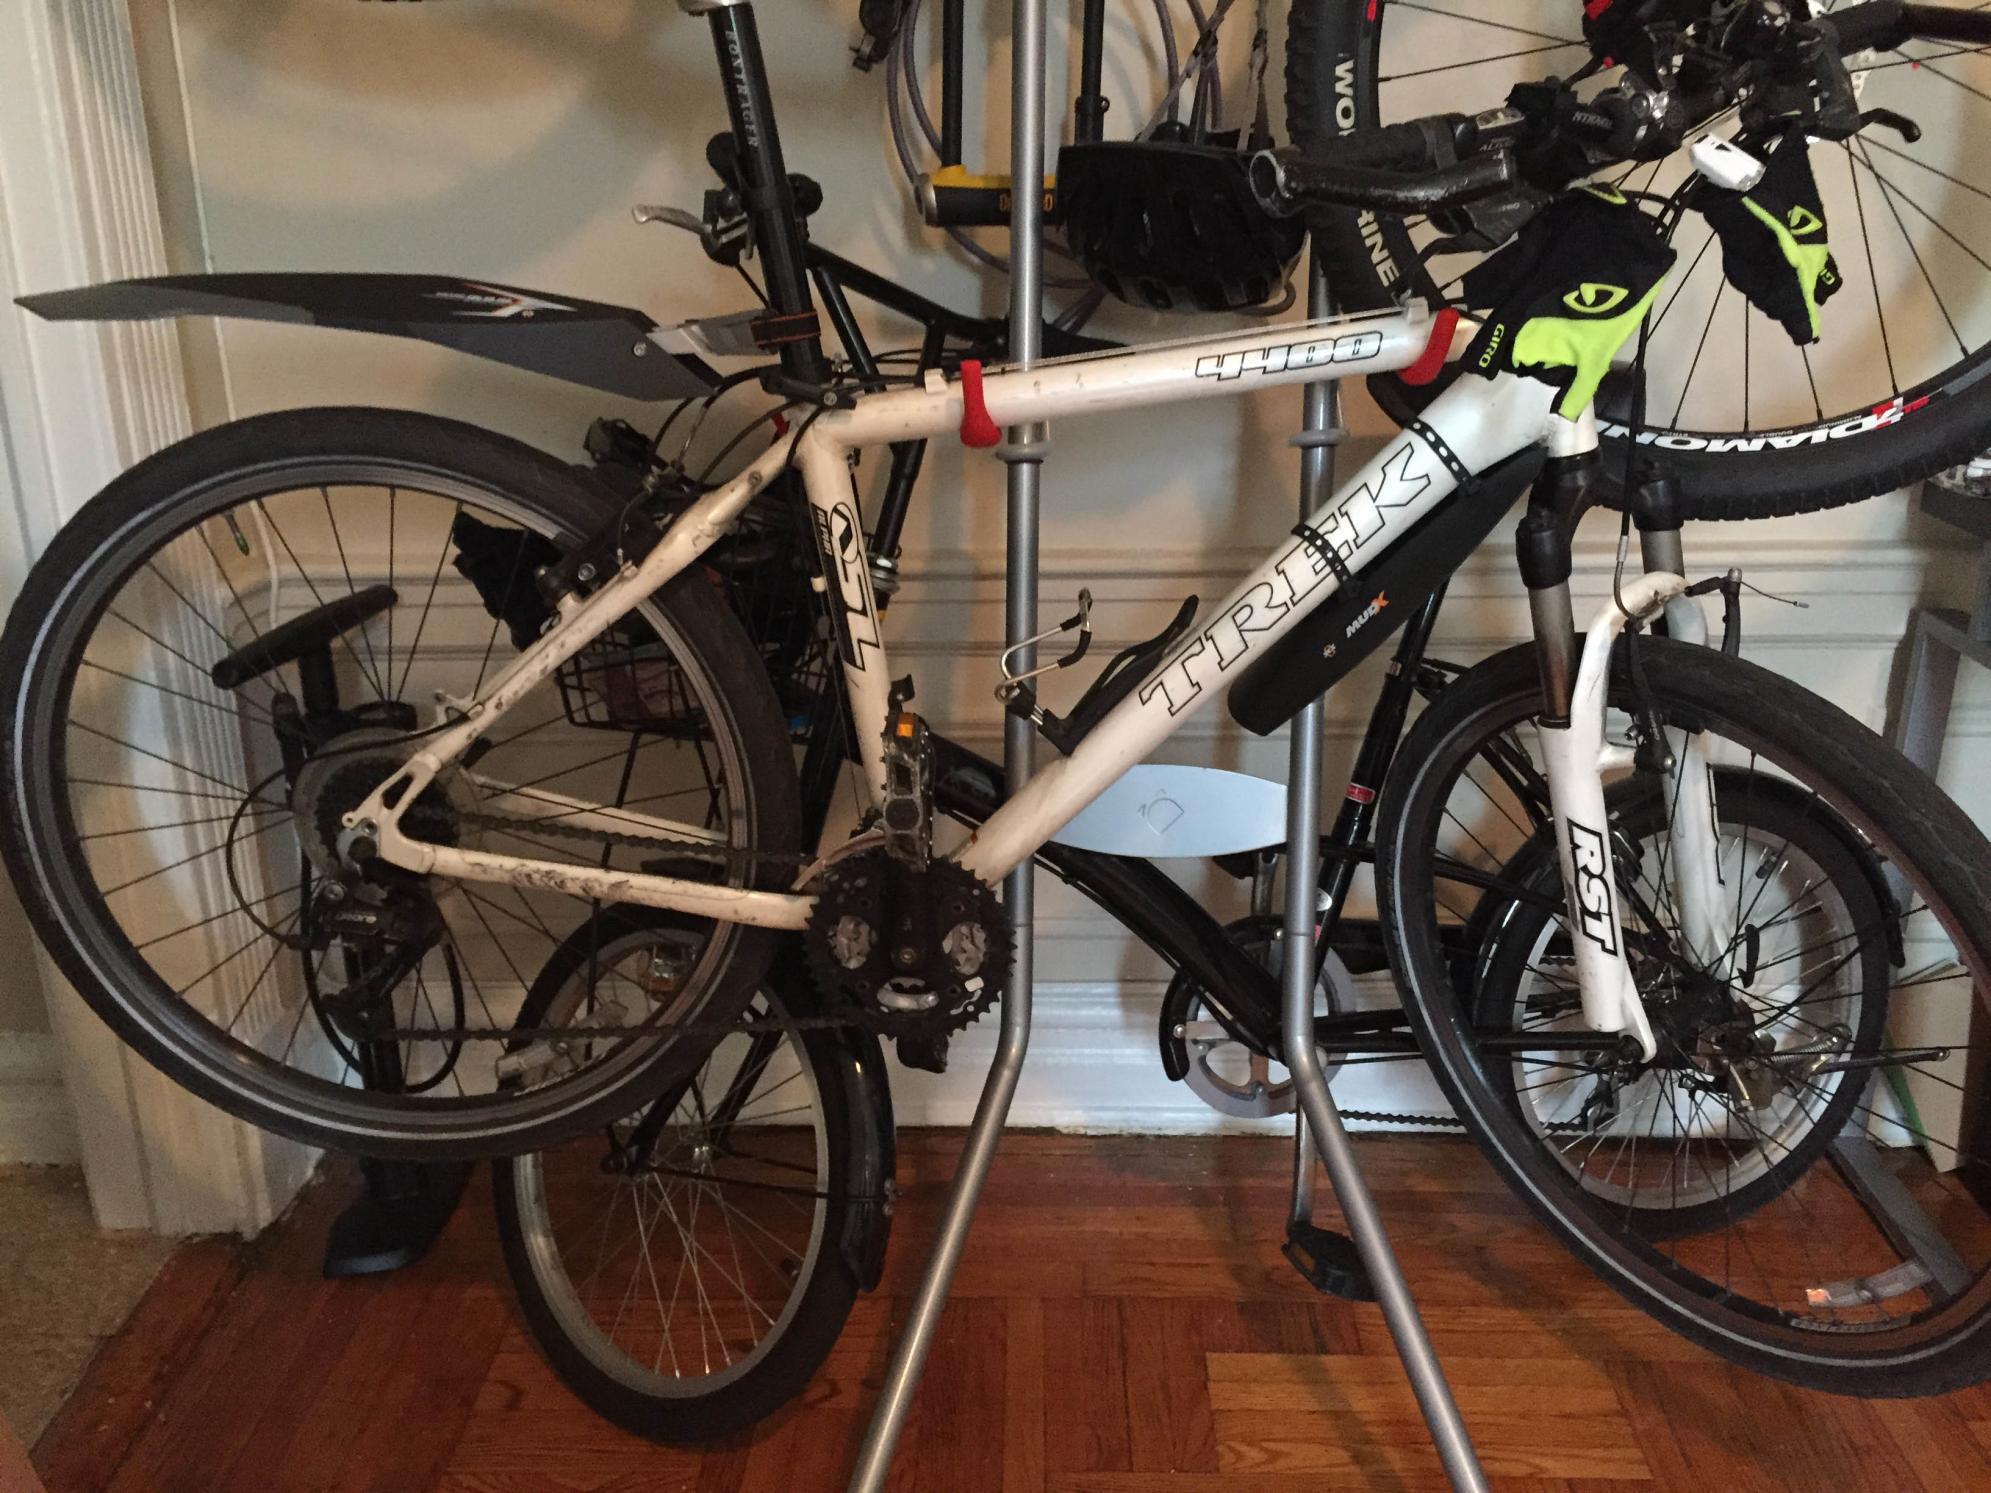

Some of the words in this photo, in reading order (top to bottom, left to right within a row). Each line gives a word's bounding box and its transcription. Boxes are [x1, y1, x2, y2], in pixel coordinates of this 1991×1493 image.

[1334, 59, 1356, 136] WO
[1195, 331, 1384, 381] 4400
[1478, 323, 1505, 368] GIRO
[1138, 441, 1432, 717] TREK
[1566, 817, 1618, 957] RST
